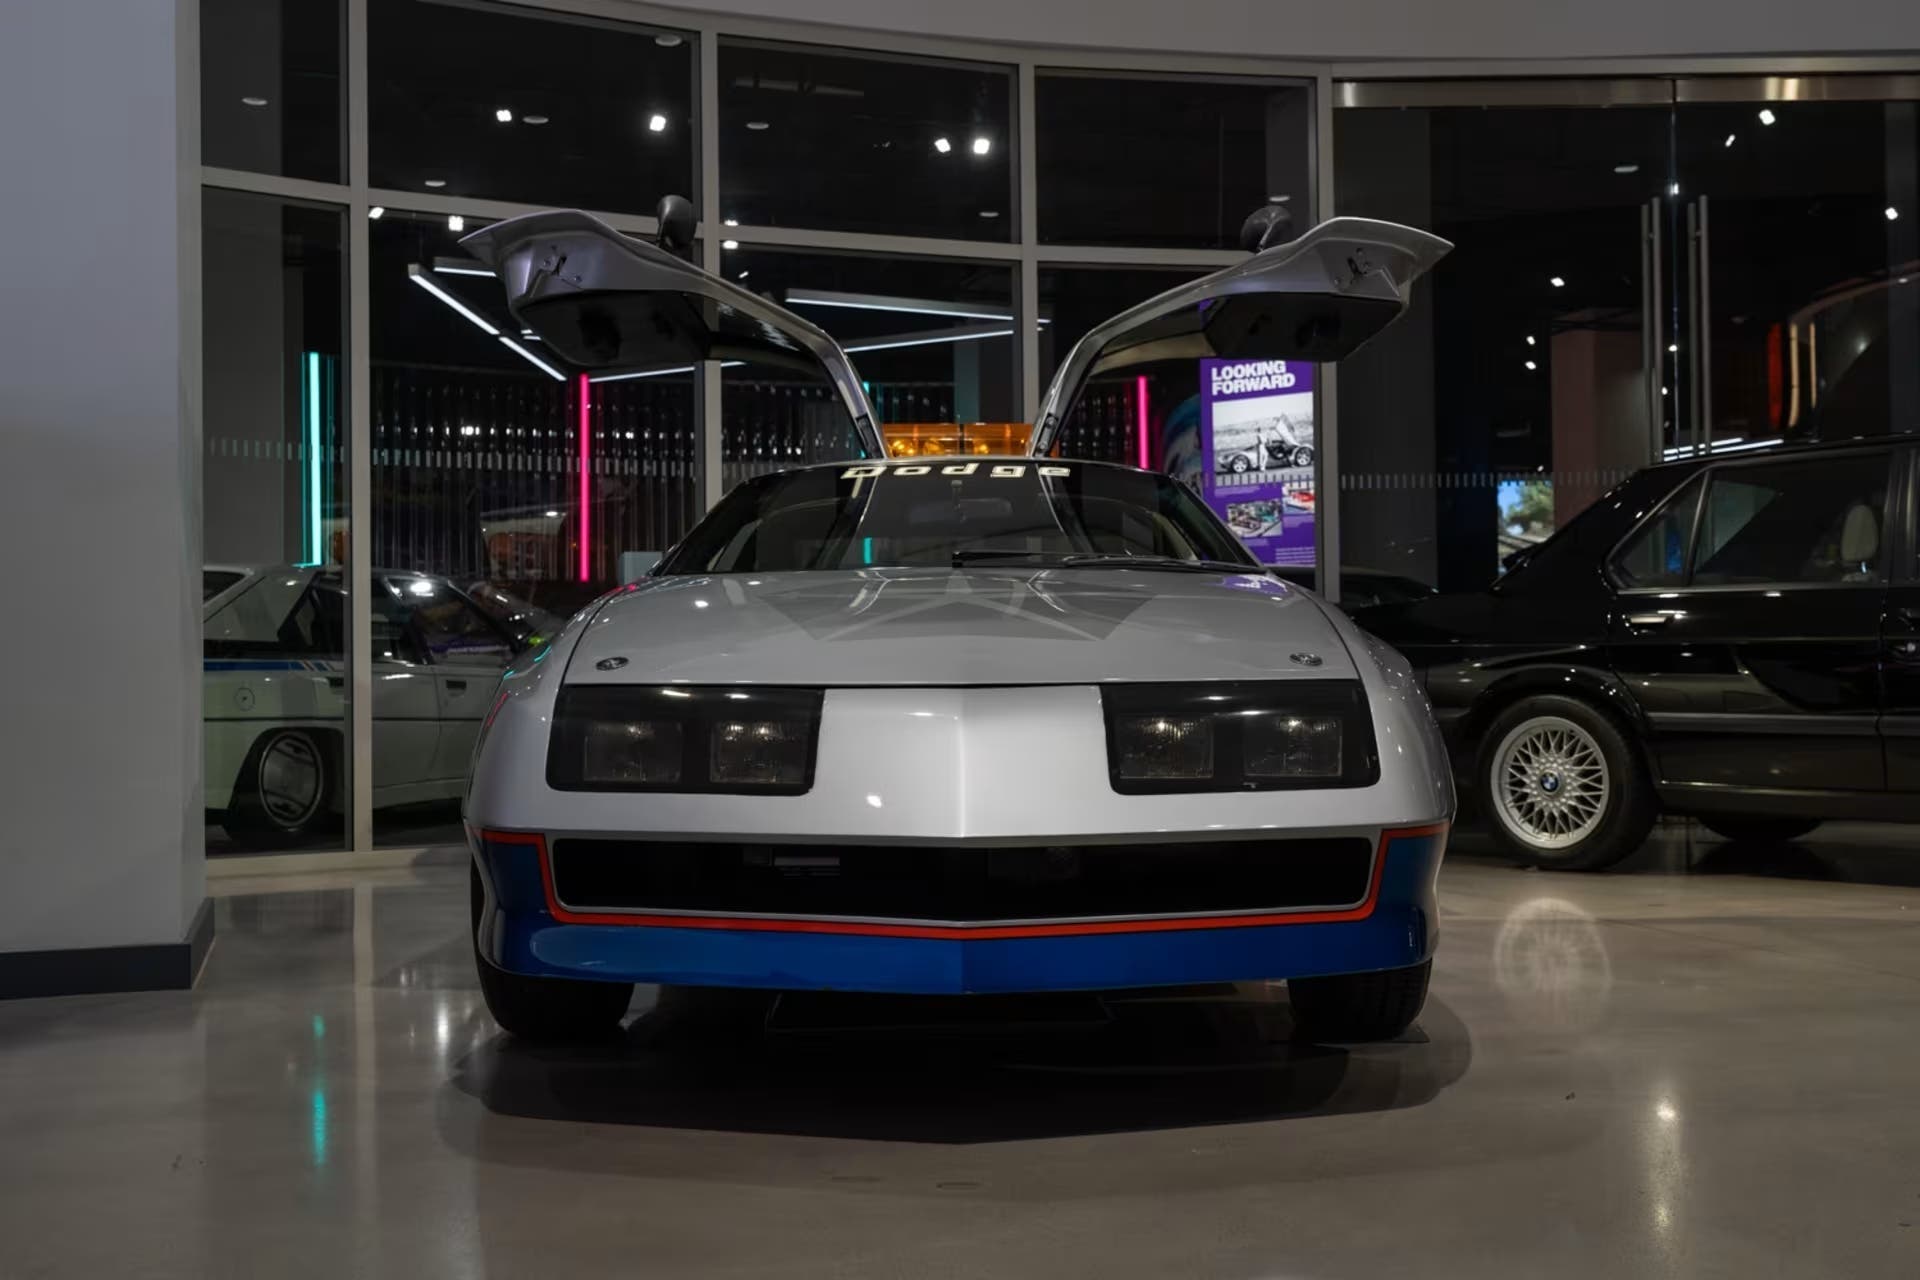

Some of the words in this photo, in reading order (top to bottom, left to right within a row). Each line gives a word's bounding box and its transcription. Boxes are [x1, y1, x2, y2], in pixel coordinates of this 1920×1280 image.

[1211, 360, 1287, 381] LOOKING
[1212, 373, 1296, 396] FORWARD
[840, 462, 1071, 479] Dodge
